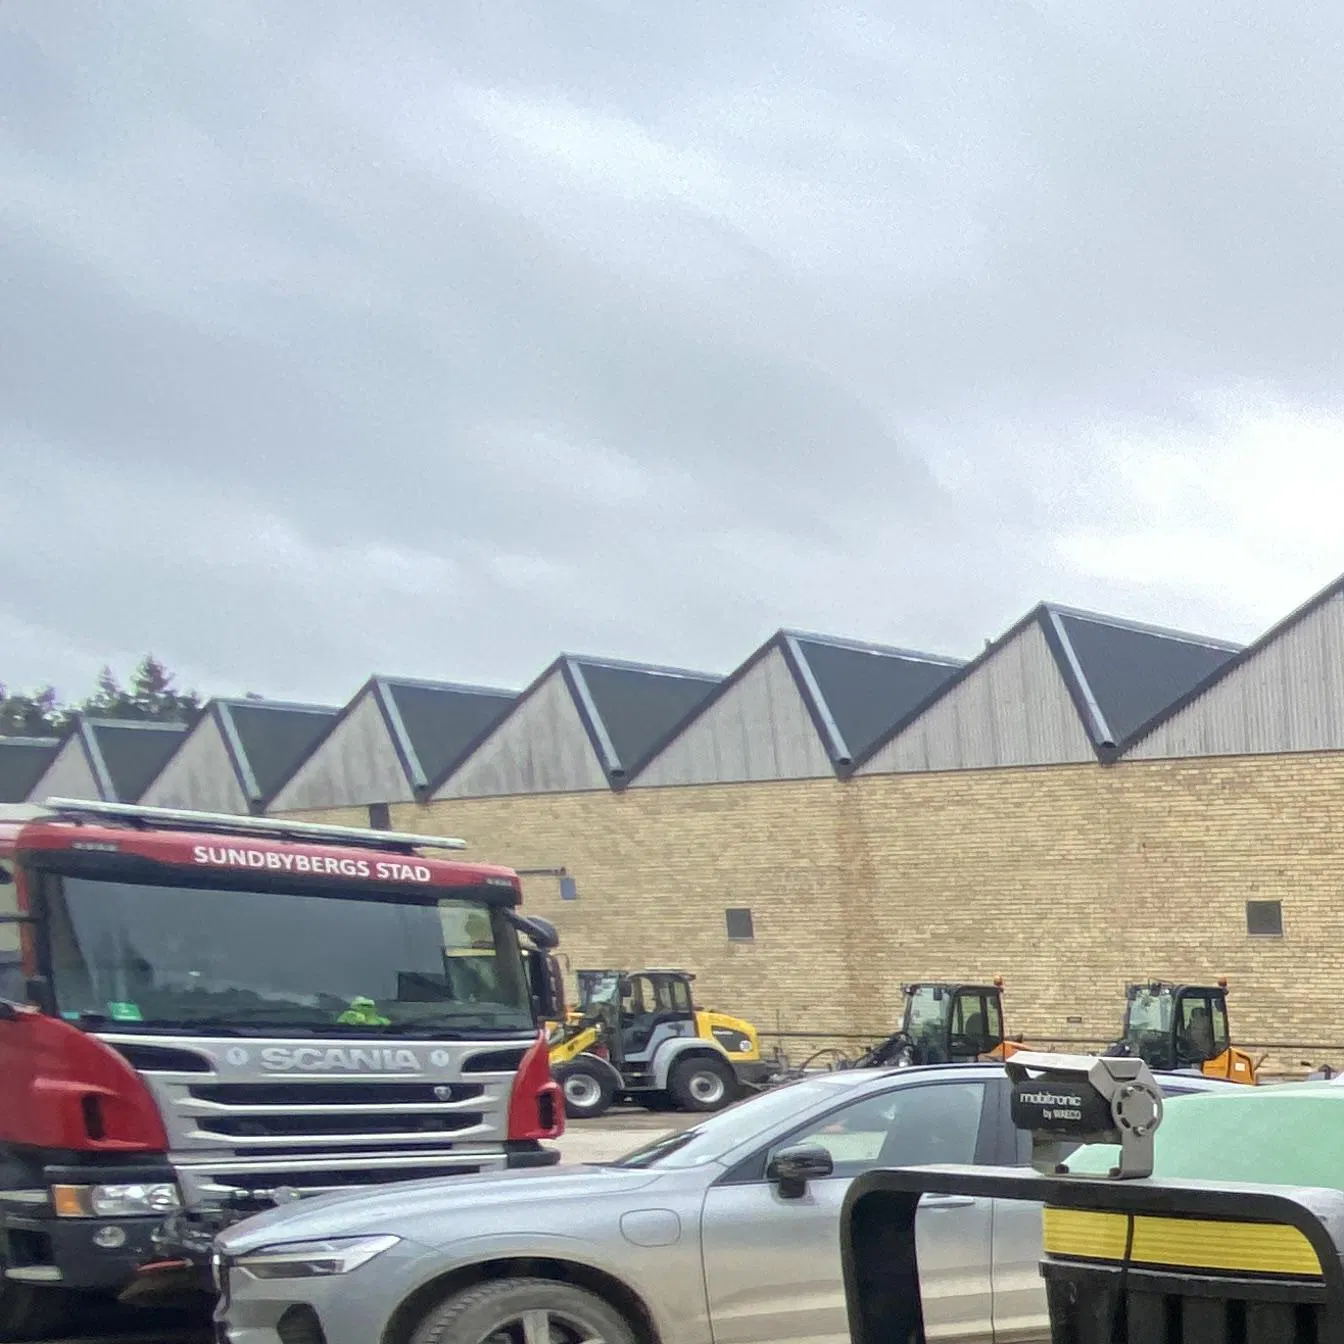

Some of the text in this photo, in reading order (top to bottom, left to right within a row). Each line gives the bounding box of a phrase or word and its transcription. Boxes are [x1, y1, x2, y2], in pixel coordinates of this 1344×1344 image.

[193, 846, 432, 883] SUNDBYBERGS STAD
[260, 1047, 424, 1072] SCANIA
[1020, 1091, 1082, 1107] mobitronic
[1042, 1108, 1053, 1120] by
